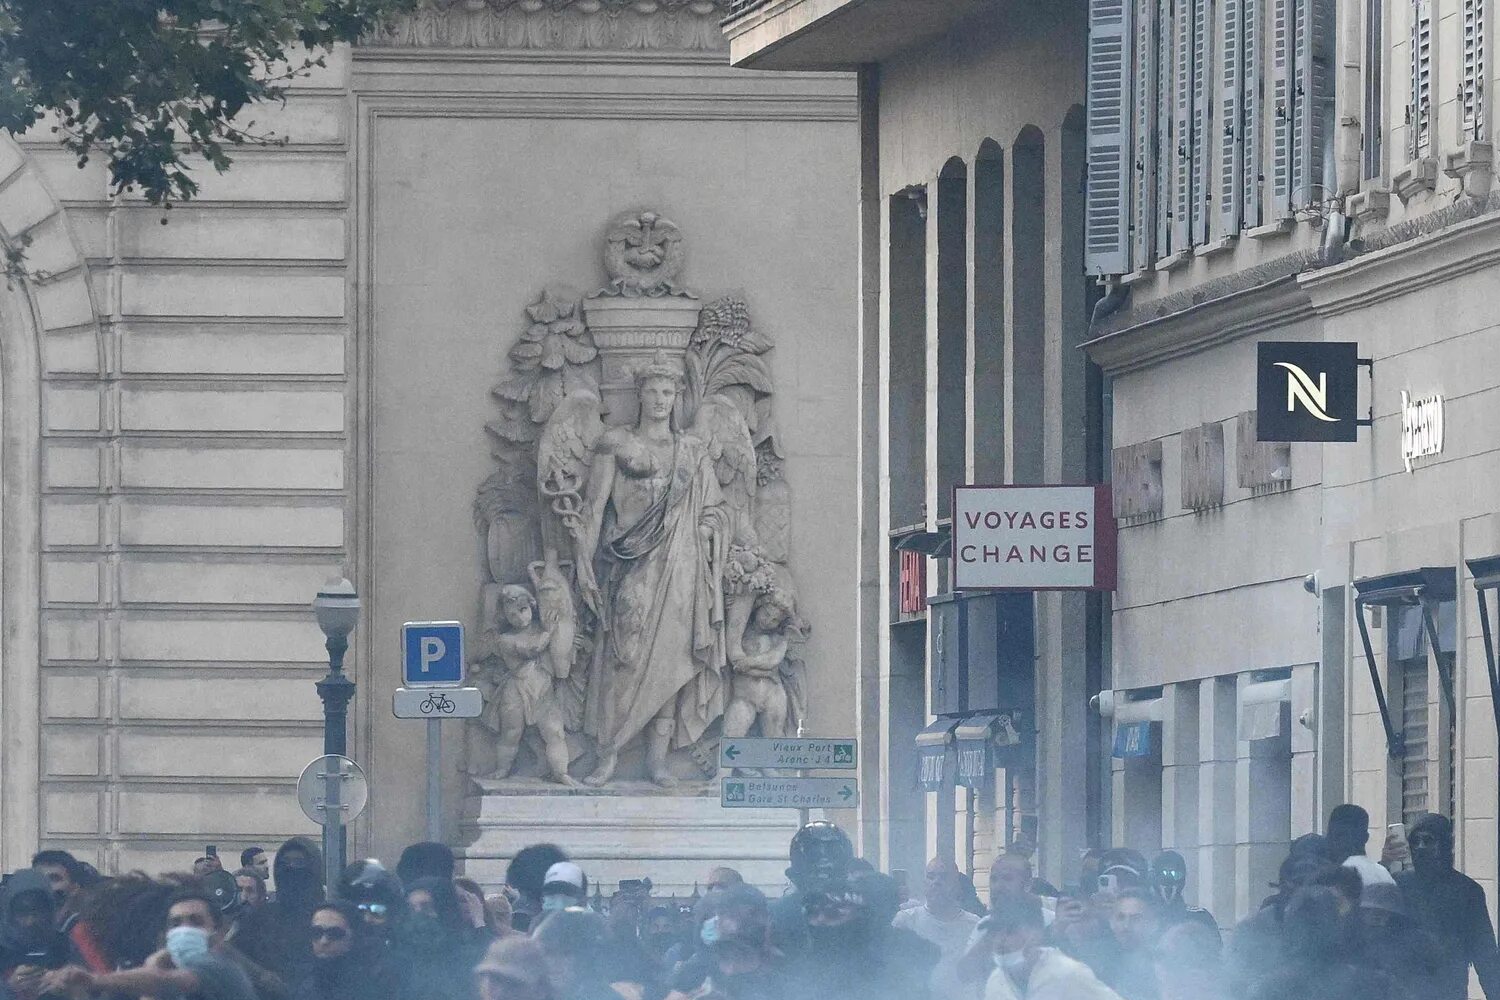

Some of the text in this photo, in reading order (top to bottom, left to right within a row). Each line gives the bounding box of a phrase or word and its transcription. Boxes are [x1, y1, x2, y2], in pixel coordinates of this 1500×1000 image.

[1273, 362, 1341, 422] N
[964, 511, 1088, 530] VOYAGES
[960, 544, 1092, 563] CHANGE
[420, 636, 446, 673] P
[773, 743, 831, 752] Vieux Port
[748, 794, 773, 803] Gare
[792, 793, 831, 803] Charles
